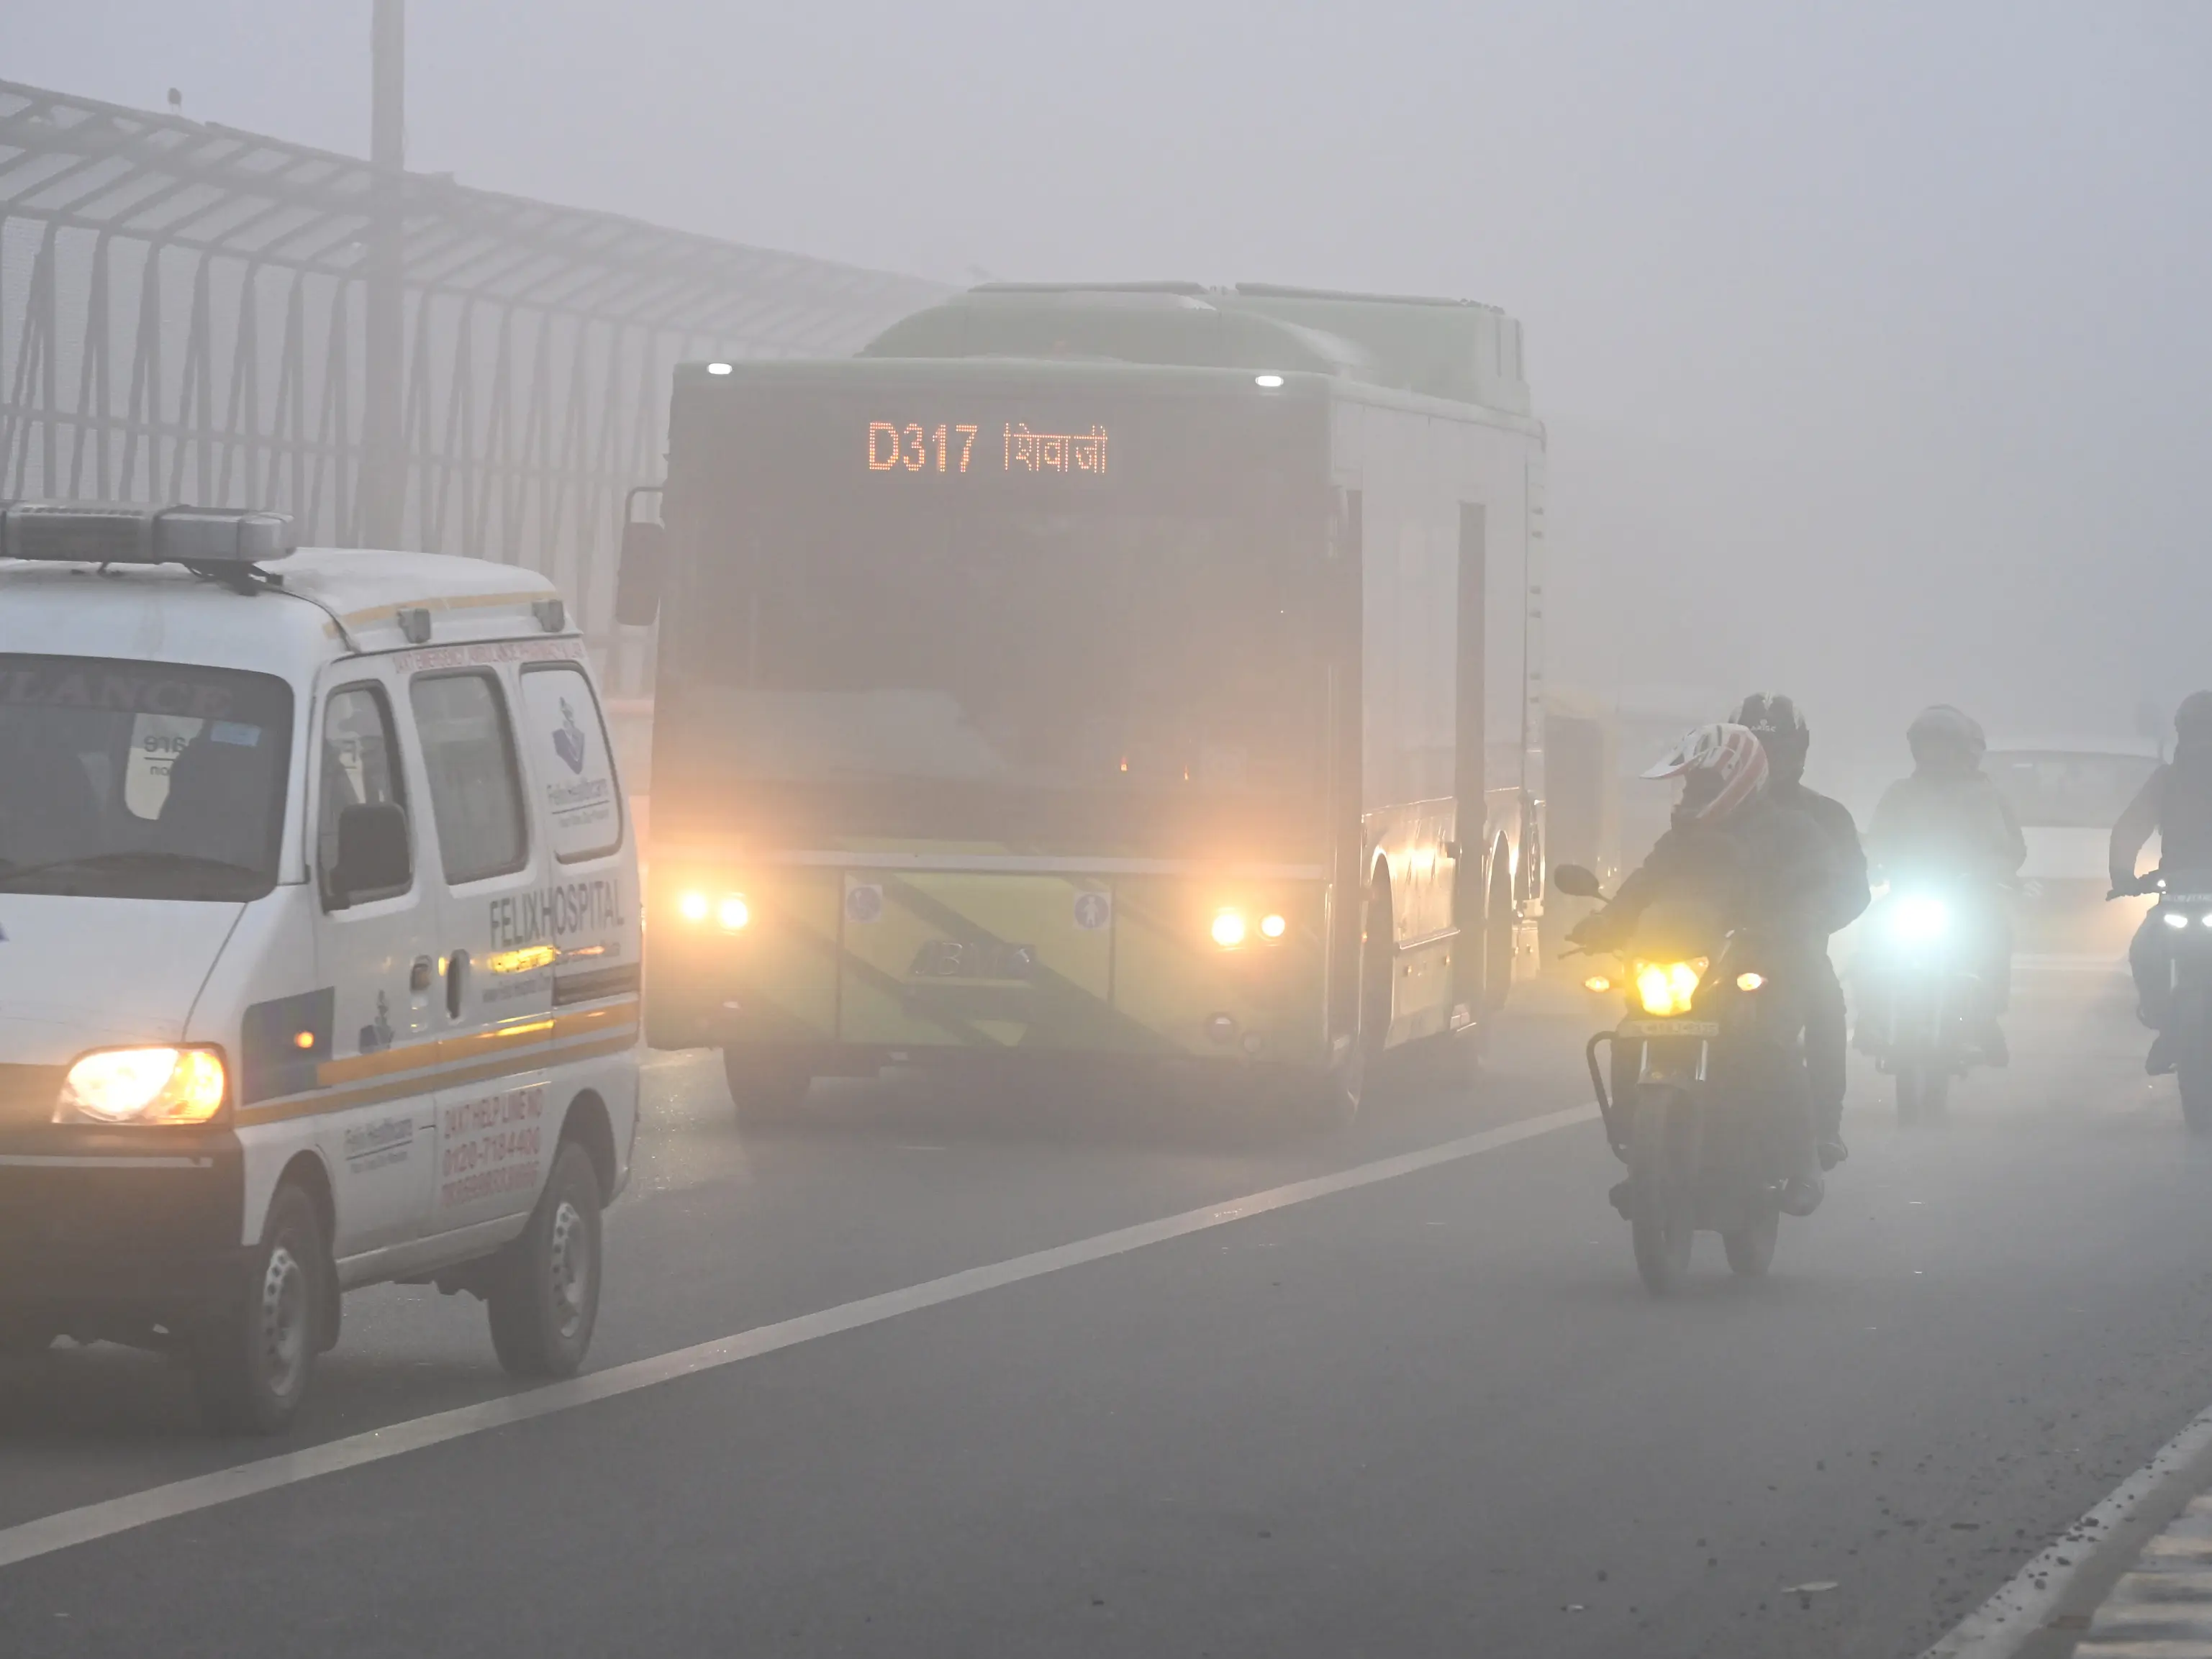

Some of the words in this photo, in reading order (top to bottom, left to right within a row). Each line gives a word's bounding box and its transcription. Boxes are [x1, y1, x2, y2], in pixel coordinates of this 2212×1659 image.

[869, 422, 977, 472] D317
[1003, 422, 1107, 473] शिवाजी
[0, 671, 232, 719] LANCE
